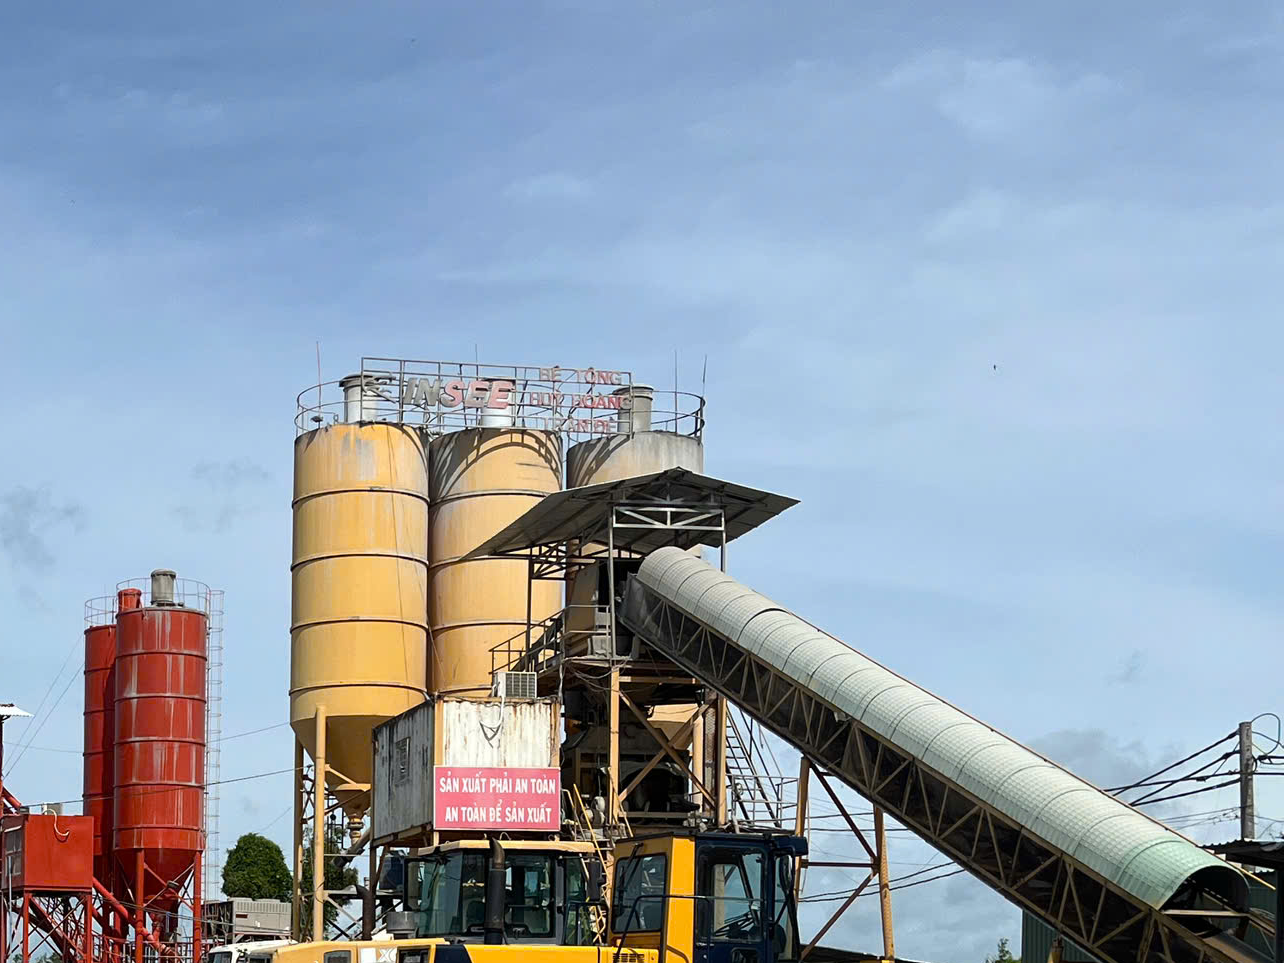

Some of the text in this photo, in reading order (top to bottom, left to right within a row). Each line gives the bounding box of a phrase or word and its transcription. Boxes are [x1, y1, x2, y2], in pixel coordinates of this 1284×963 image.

[403, 377, 513, 409] INSEE
[439, 771, 556, 794] SẢN XUẤT PHẢI AN TOÀN
[445, 799, 552, 823] AN TOÀN ĐỂ SẢN XUẤT
